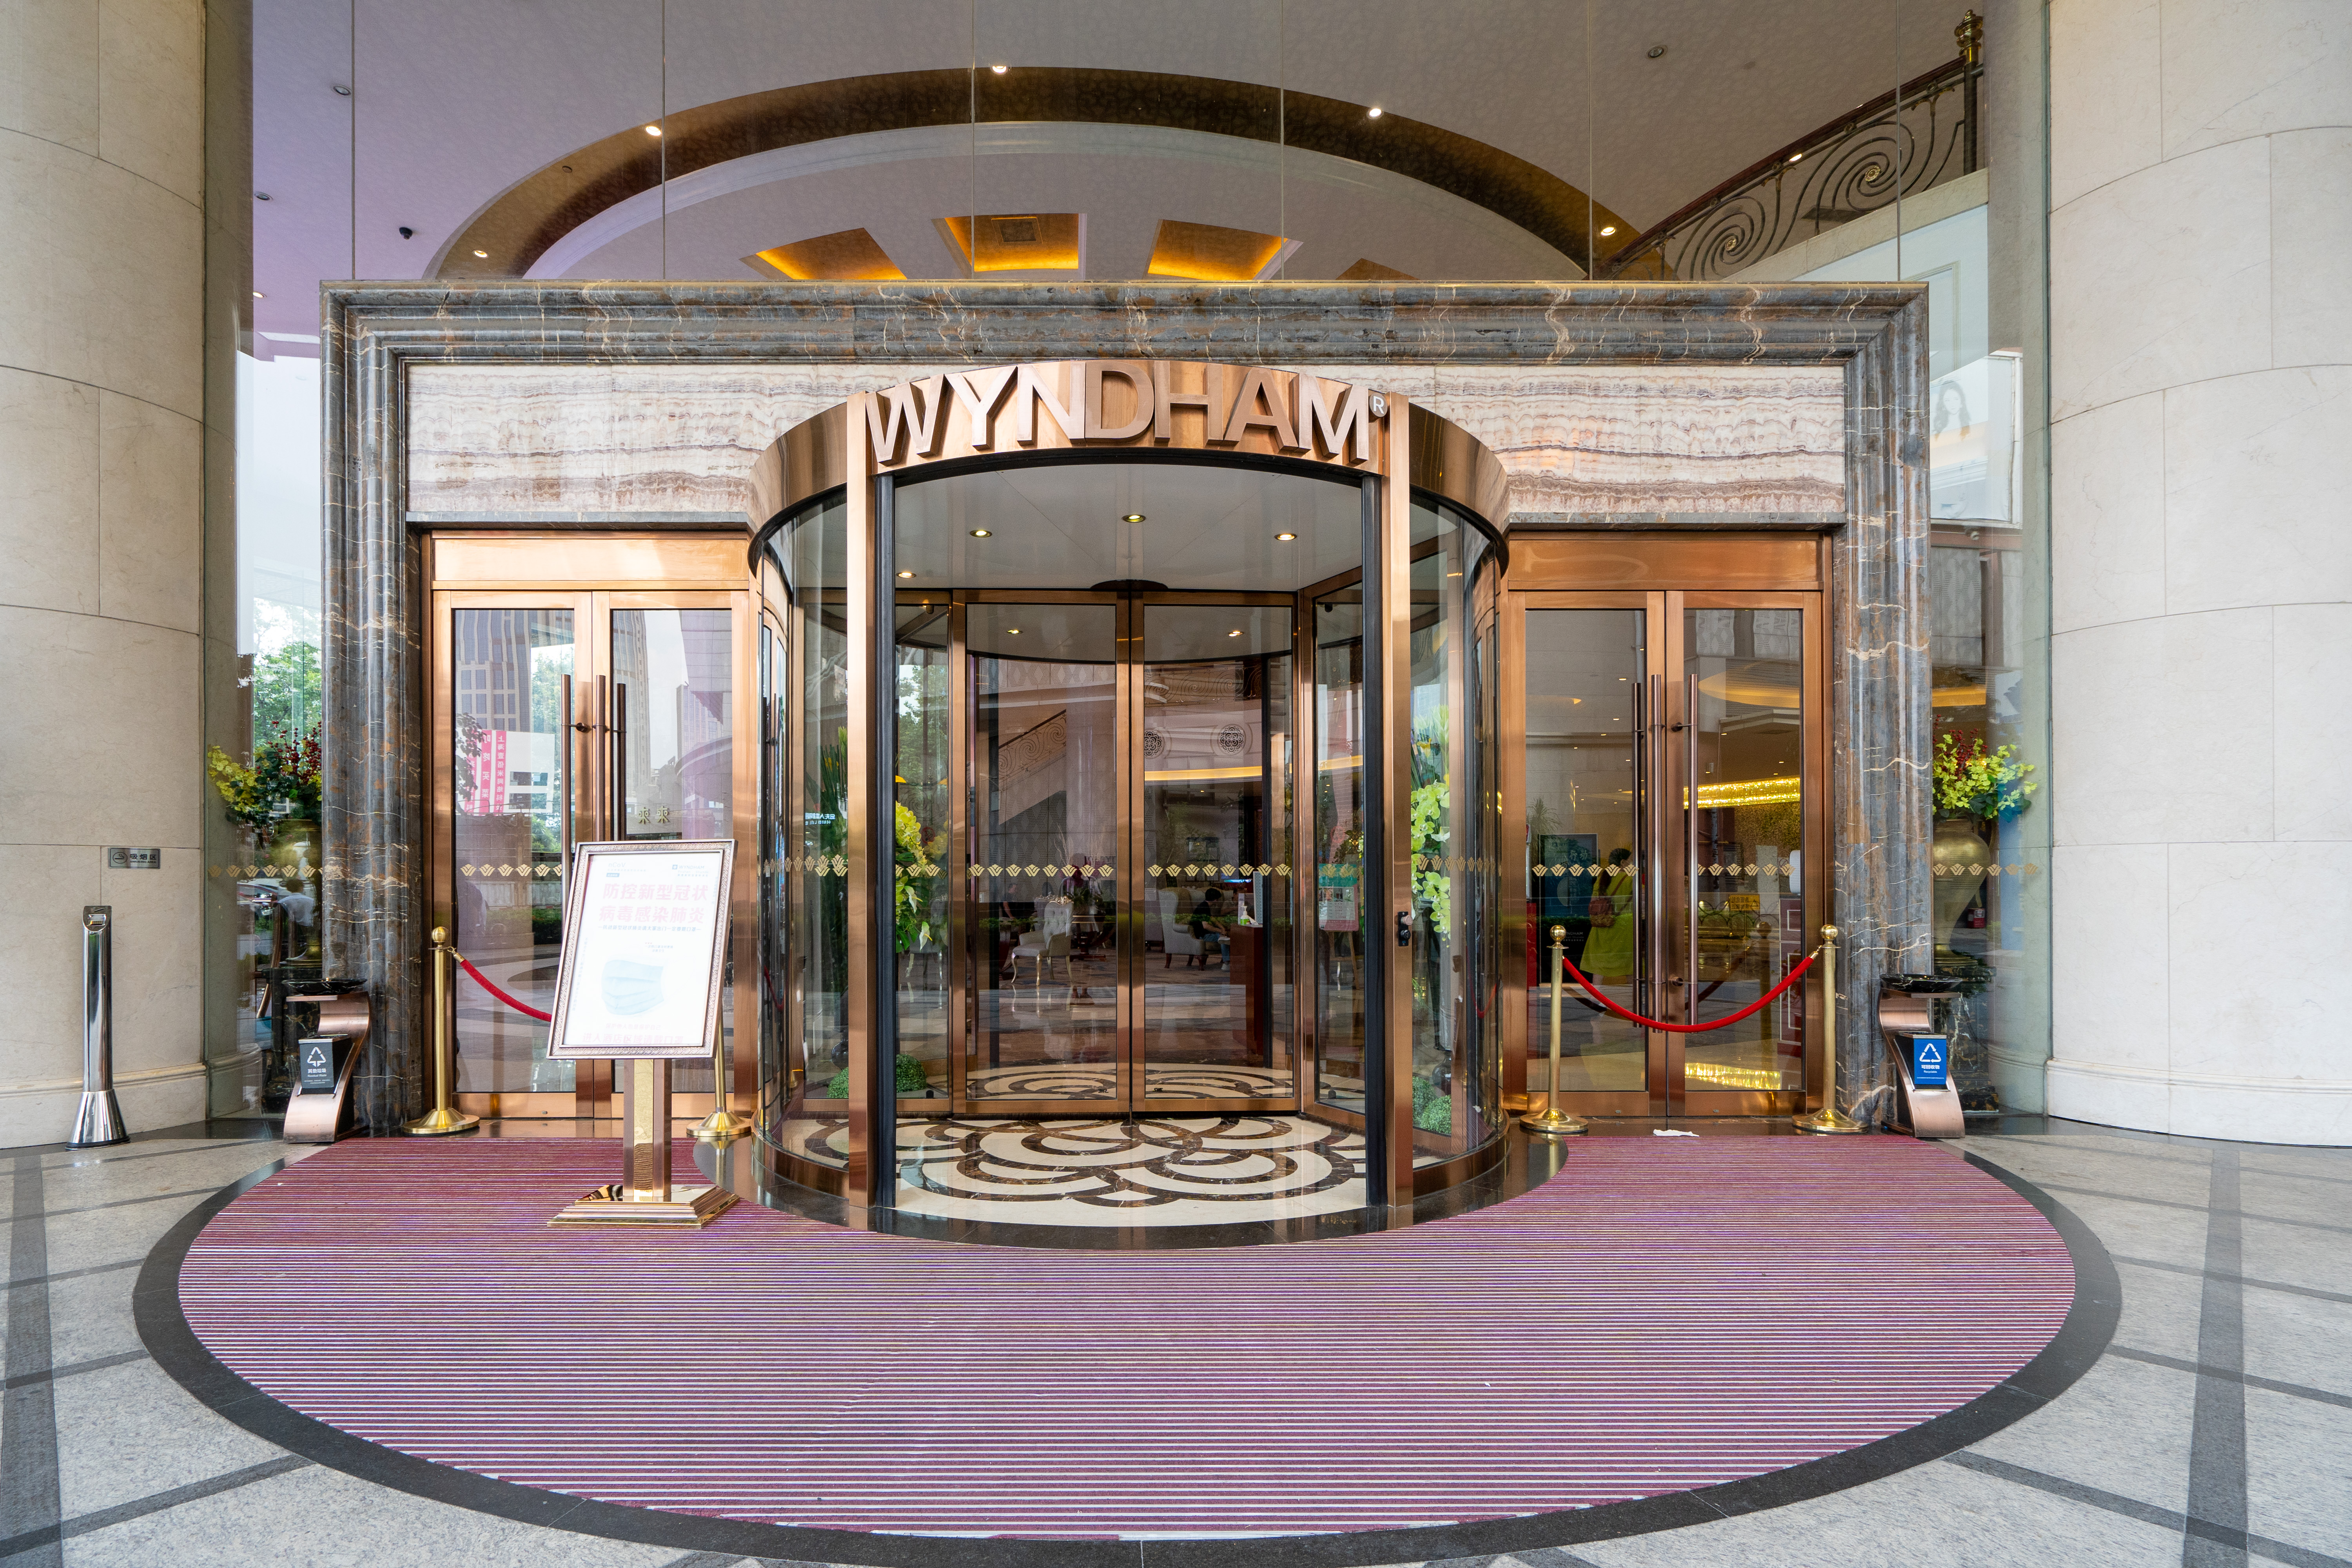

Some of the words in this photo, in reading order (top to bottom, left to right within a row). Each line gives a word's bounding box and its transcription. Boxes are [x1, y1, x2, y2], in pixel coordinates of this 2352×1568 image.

[866, 361, 1369, 465] WYNDHAM
[603, 884, 708, 901] 防控新型冠状
[599, 906, 704, 924] 病毒感染肺炎
